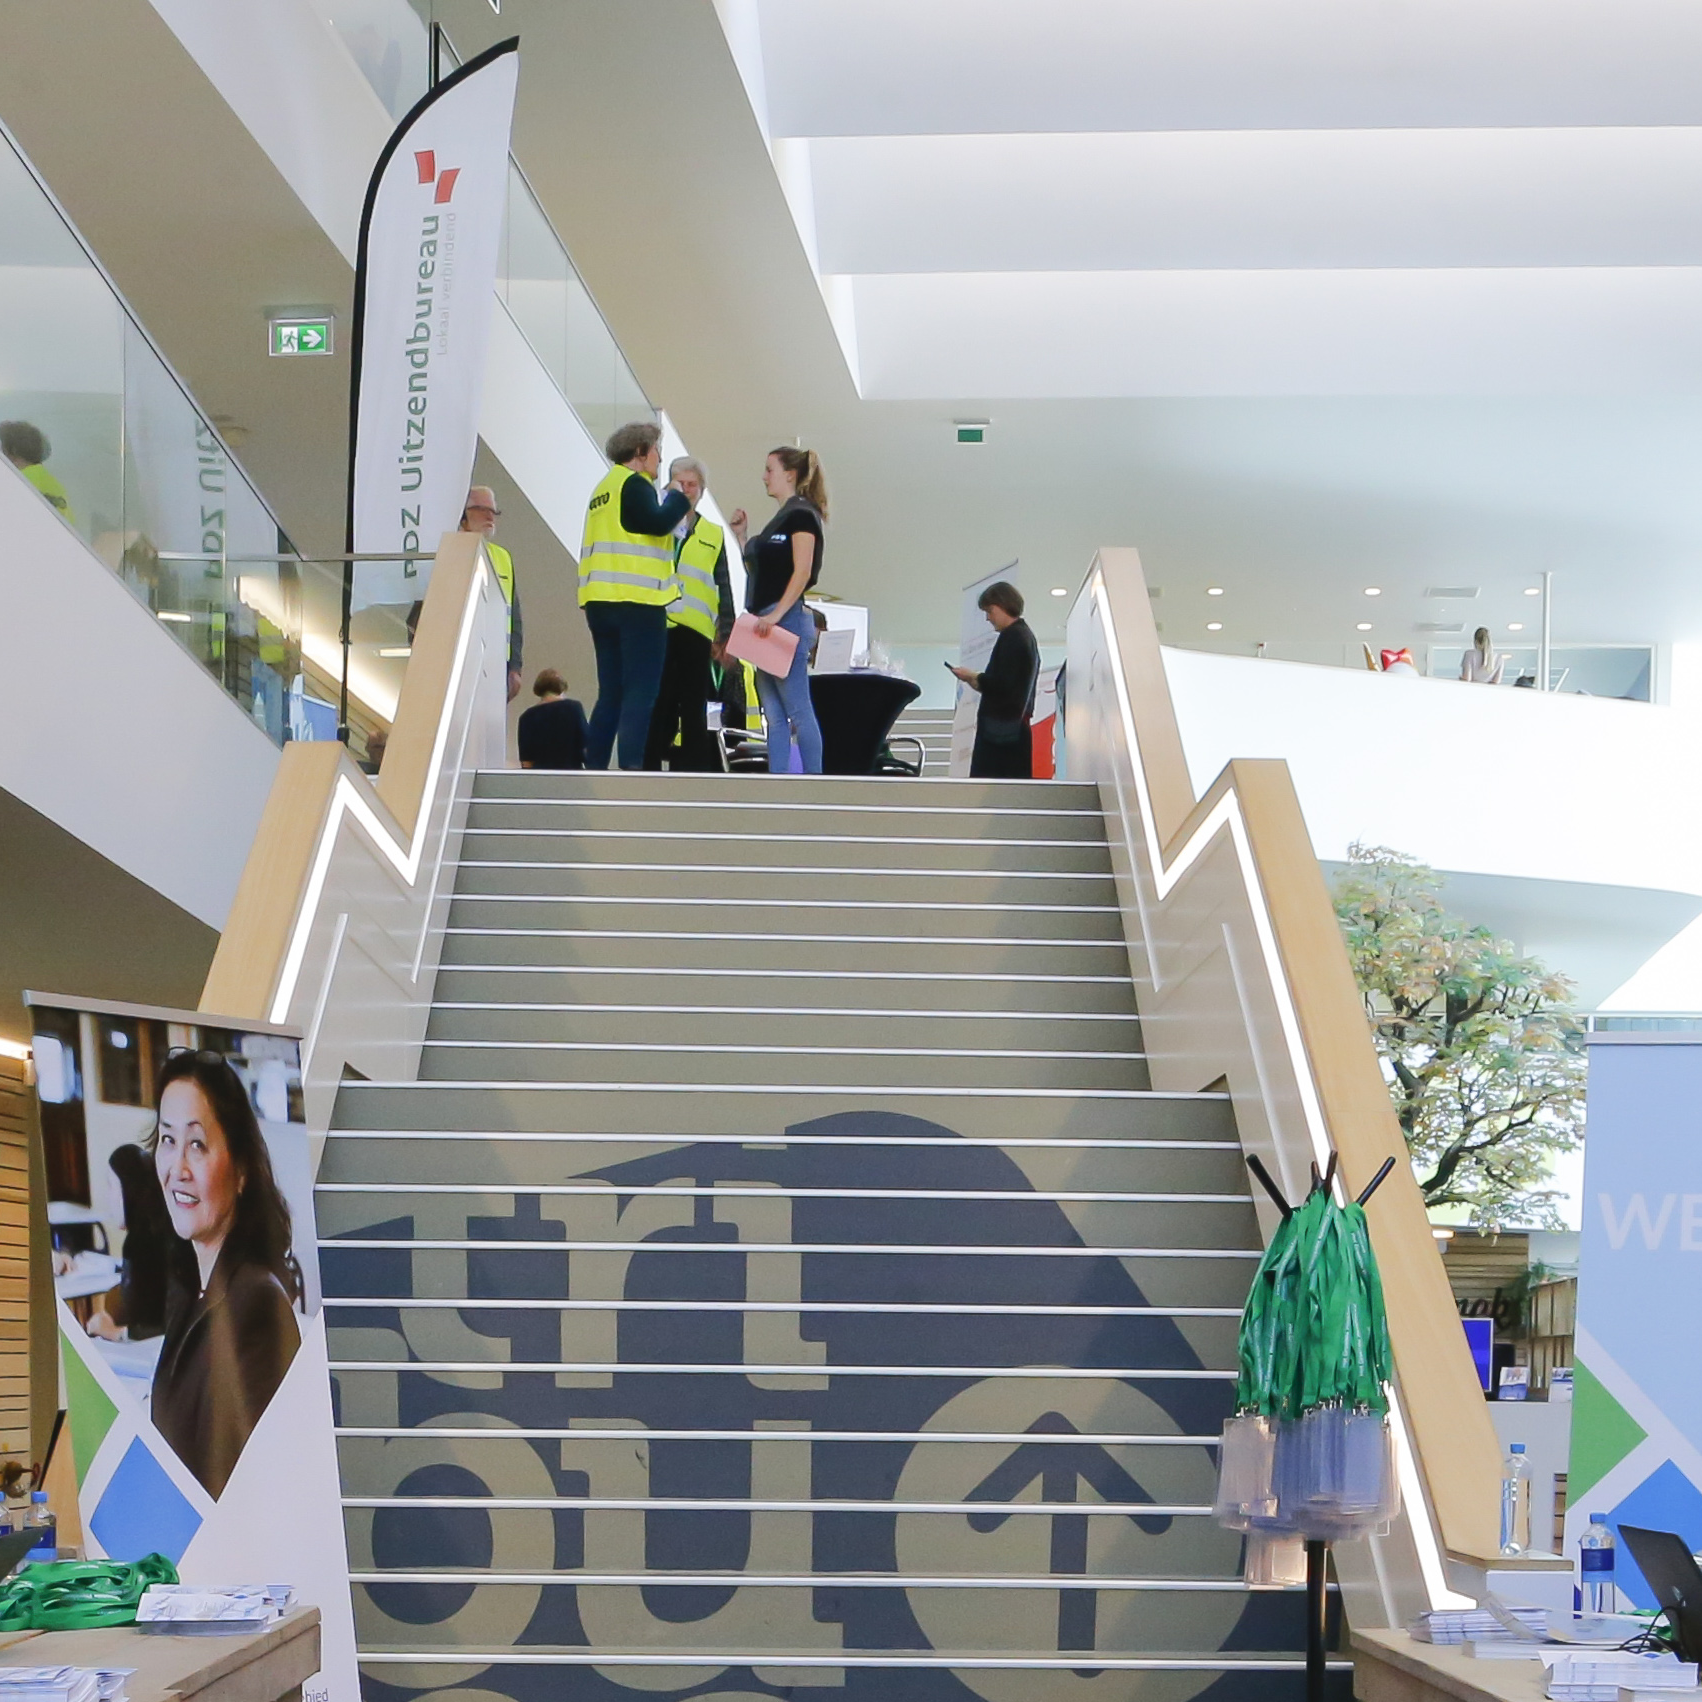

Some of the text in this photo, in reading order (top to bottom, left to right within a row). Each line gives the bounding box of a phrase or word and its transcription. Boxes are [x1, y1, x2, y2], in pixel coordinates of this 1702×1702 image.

[399, 215, 440, 492] Uitzendbureau
[436, 212, 457, 356] Lokaal verbindend
